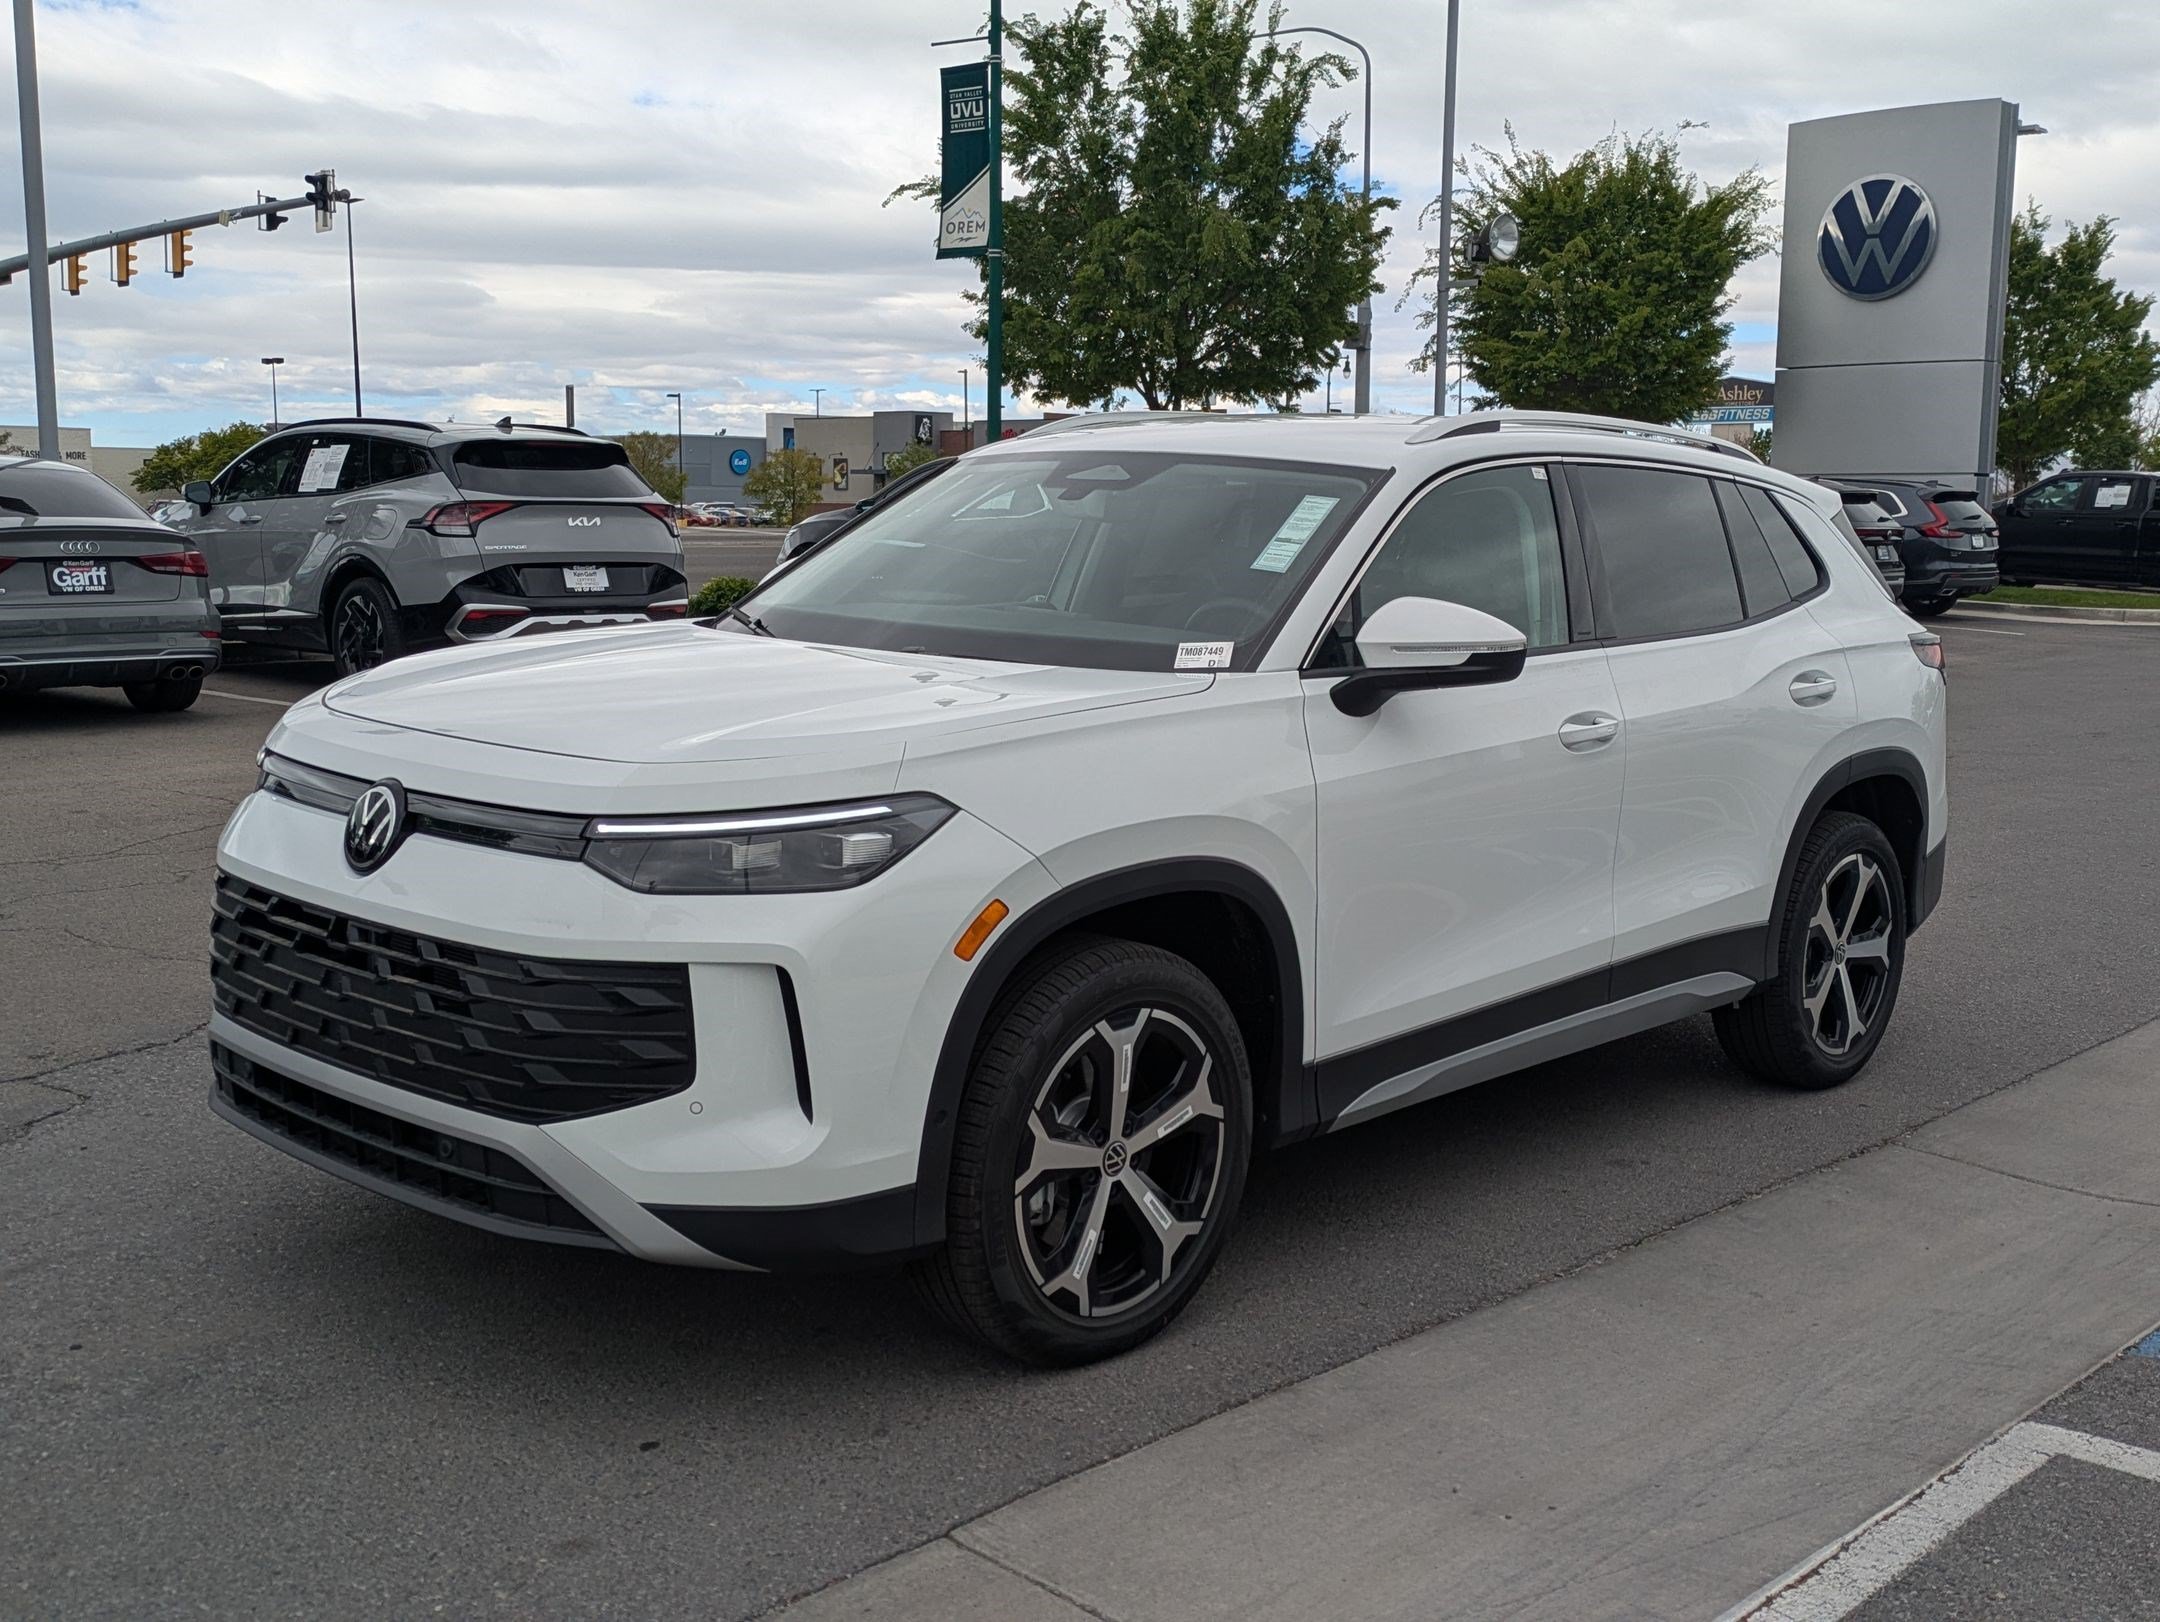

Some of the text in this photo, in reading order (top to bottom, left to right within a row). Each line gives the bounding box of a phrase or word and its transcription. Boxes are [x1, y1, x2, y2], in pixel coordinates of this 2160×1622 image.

[950, 120, 985, 130] UNIVERSITY
[945, 220, 986, 235] OREM
[1717, 384, 1764, 404] Ashley
[66, 451, 87, 460] MORE
[52, 566, 107, 587] Garff
[1180, 646, 1224, 657] TM087449
